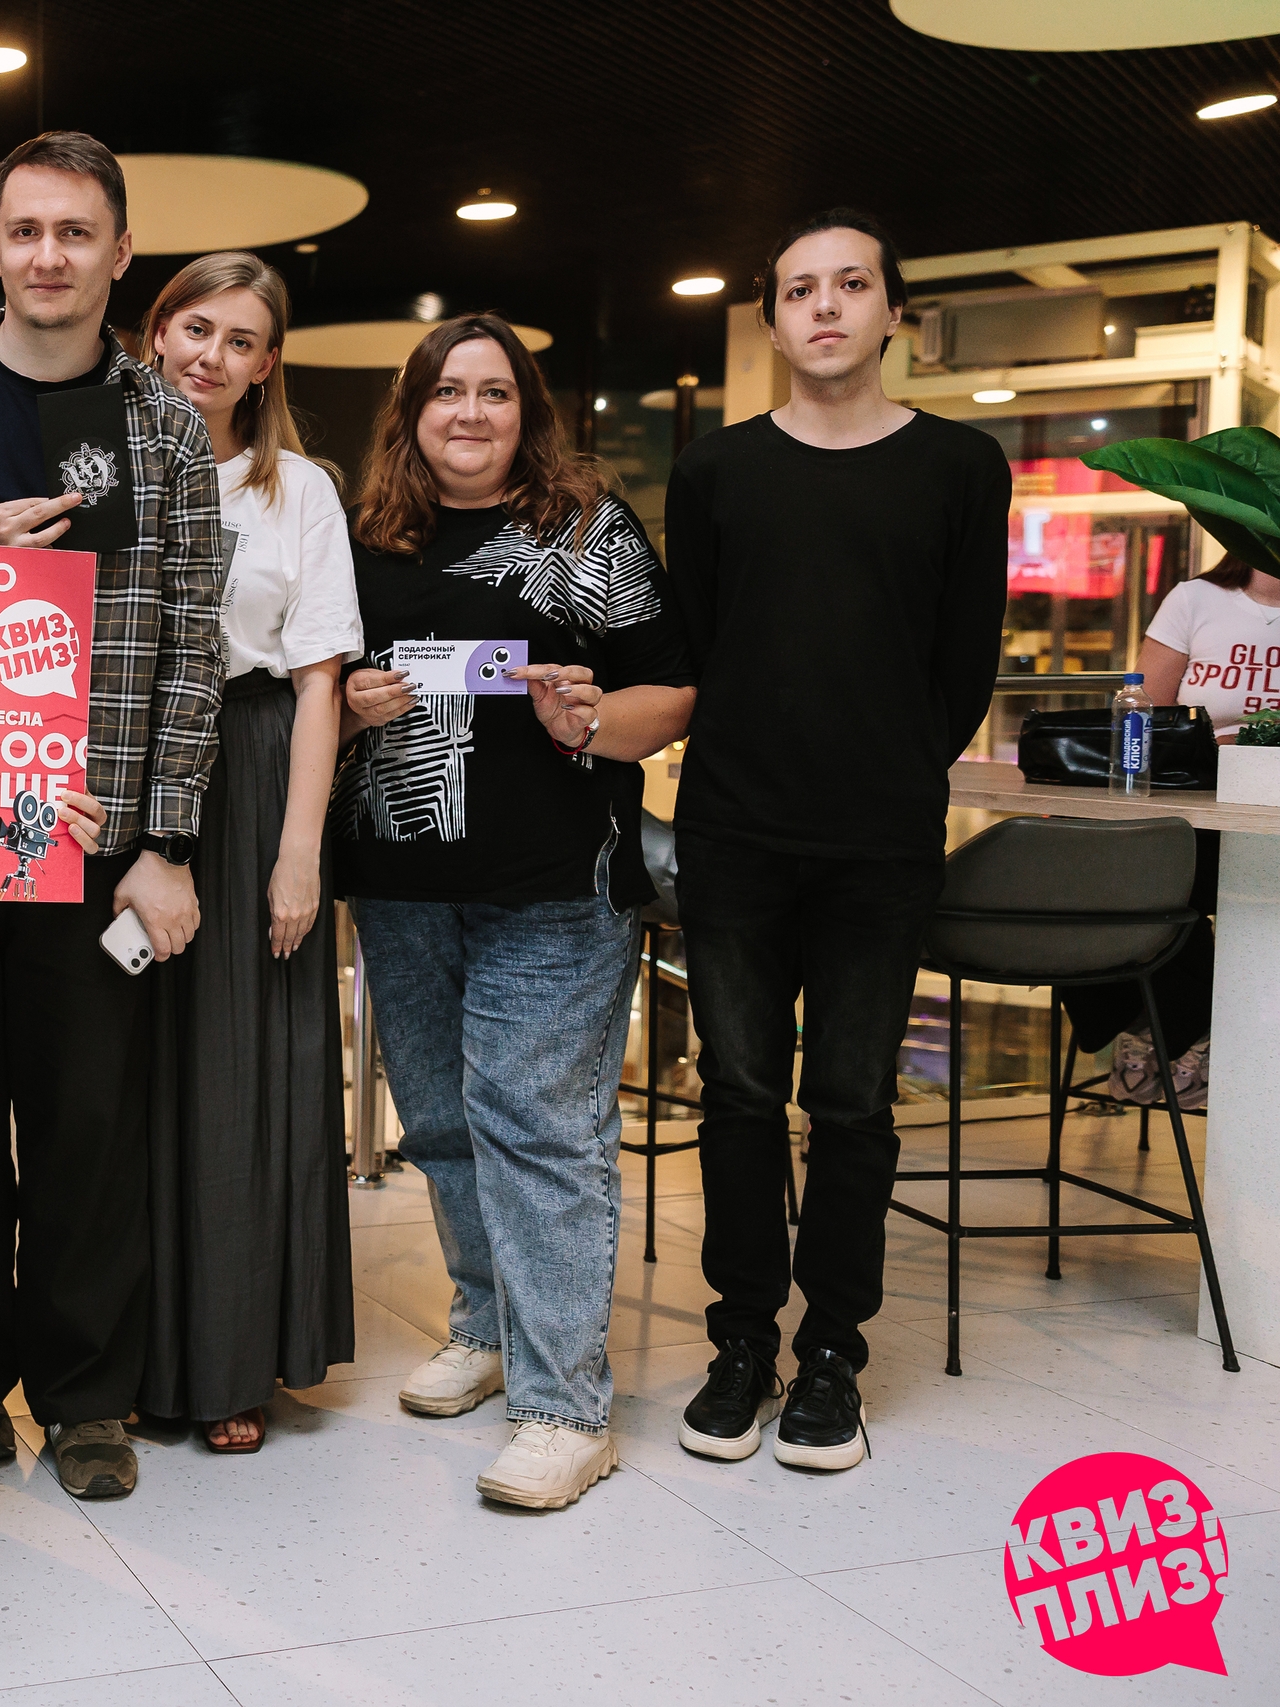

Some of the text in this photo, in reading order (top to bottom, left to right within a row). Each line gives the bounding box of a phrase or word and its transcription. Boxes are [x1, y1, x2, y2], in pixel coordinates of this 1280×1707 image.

[220, 577, 239, 615] Ulysses
[398, 644, 456, 653] ПОДАРОЧНЫЙ
[1122, 719, 1131, 769] ДАВЫДОВСКИЙ
[1130, 738, 1141, 769] КЛЮЧ
